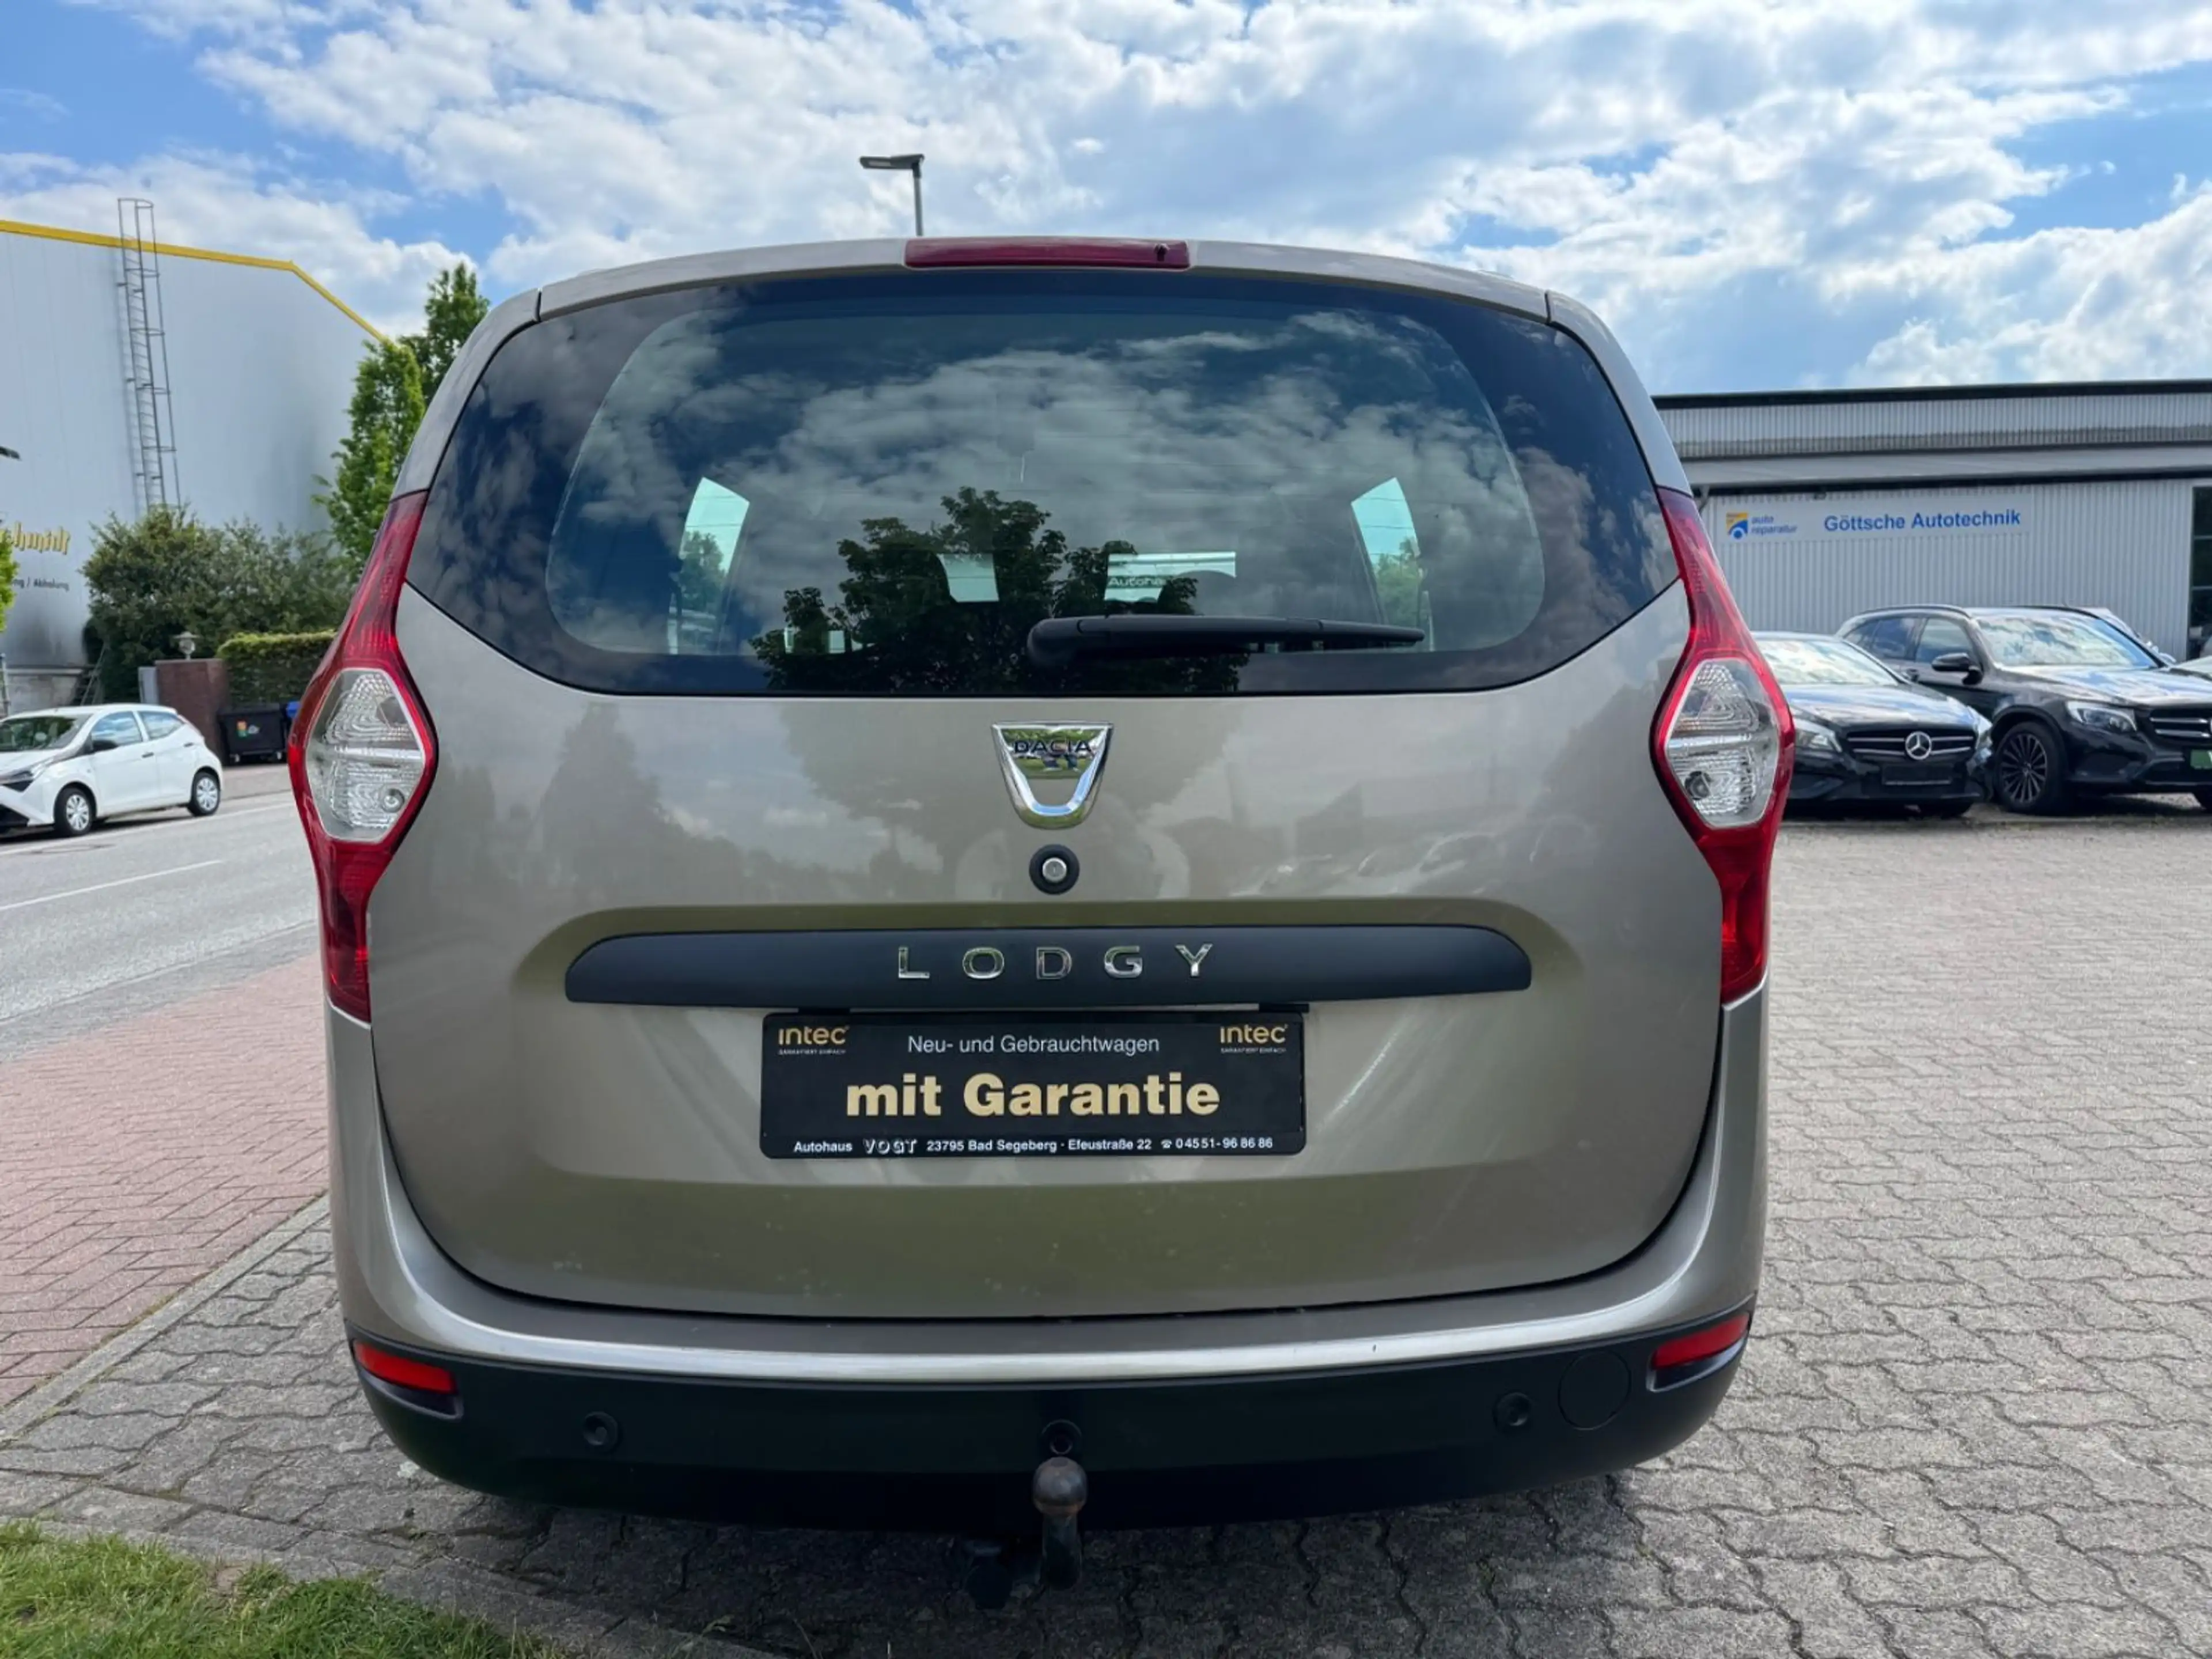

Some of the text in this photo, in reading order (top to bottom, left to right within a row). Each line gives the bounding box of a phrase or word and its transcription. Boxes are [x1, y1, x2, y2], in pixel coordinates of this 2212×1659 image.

[1751, 514, 1774, 525] auto
[1824, 509, 2020, 532] Göttsche Autotechnik
[1014, 740, 1092, 756] DACIA
[898, 943, 1213, 980] LODGY
[778, 1026, 846, 1045] intec
[1220, 1024, 1286, 1044] intec
[907, 1035, 1160, 1056] Neu- und Gebrauchtwagen
[846, 1071, 1221, 1116] mit Garantie
[794, 1141, 853, 1152] Autohaus
[863, 1138, 918, 1154] VOGT
[926, 1140, 964, 1152] 23795
[968, 1140, 993, 1151] Bad
[996, 1139, 1058, 1153] Segeberg
[1137, 1139, 1152, 1150] 22
